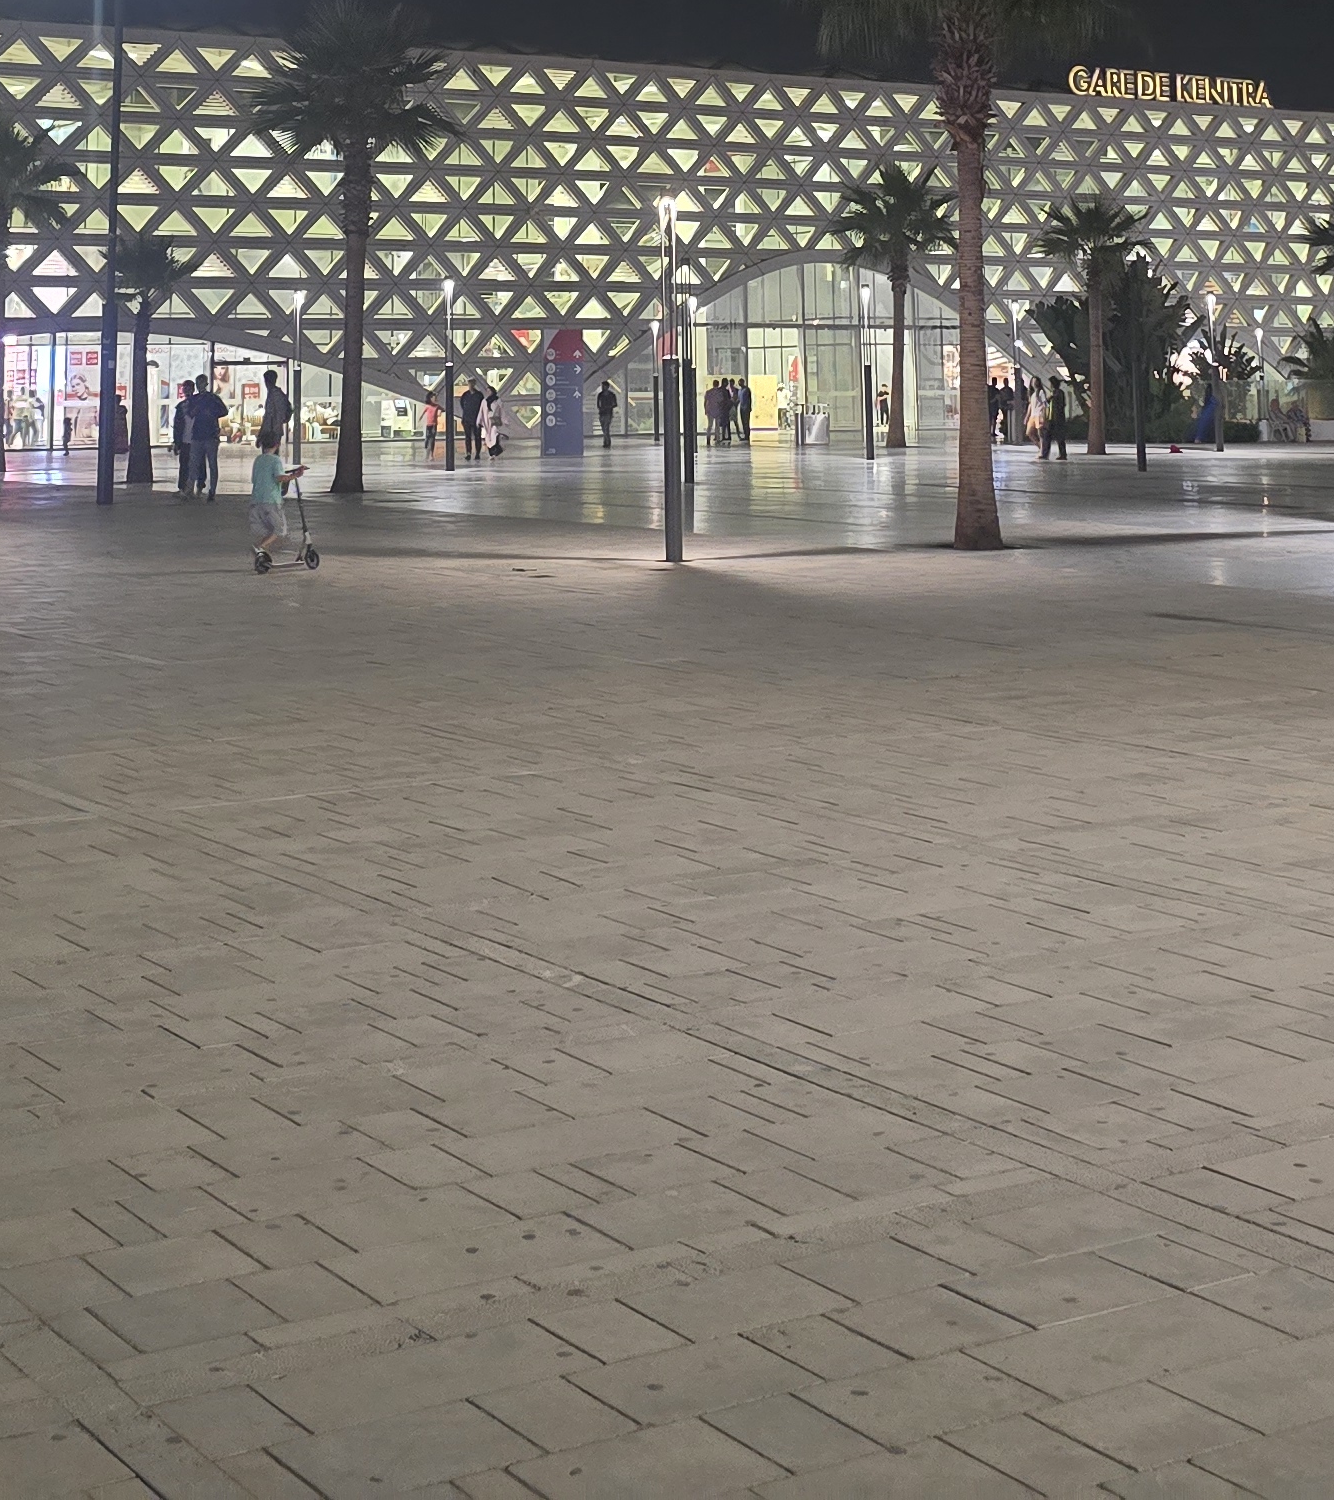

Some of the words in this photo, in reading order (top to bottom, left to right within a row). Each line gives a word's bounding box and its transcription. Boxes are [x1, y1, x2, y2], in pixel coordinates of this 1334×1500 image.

[1068, 65, 1135, 98] GARE
[1136, 70, 1170, 101] DE
[1176, 74, 1274, 108] KENITRA
